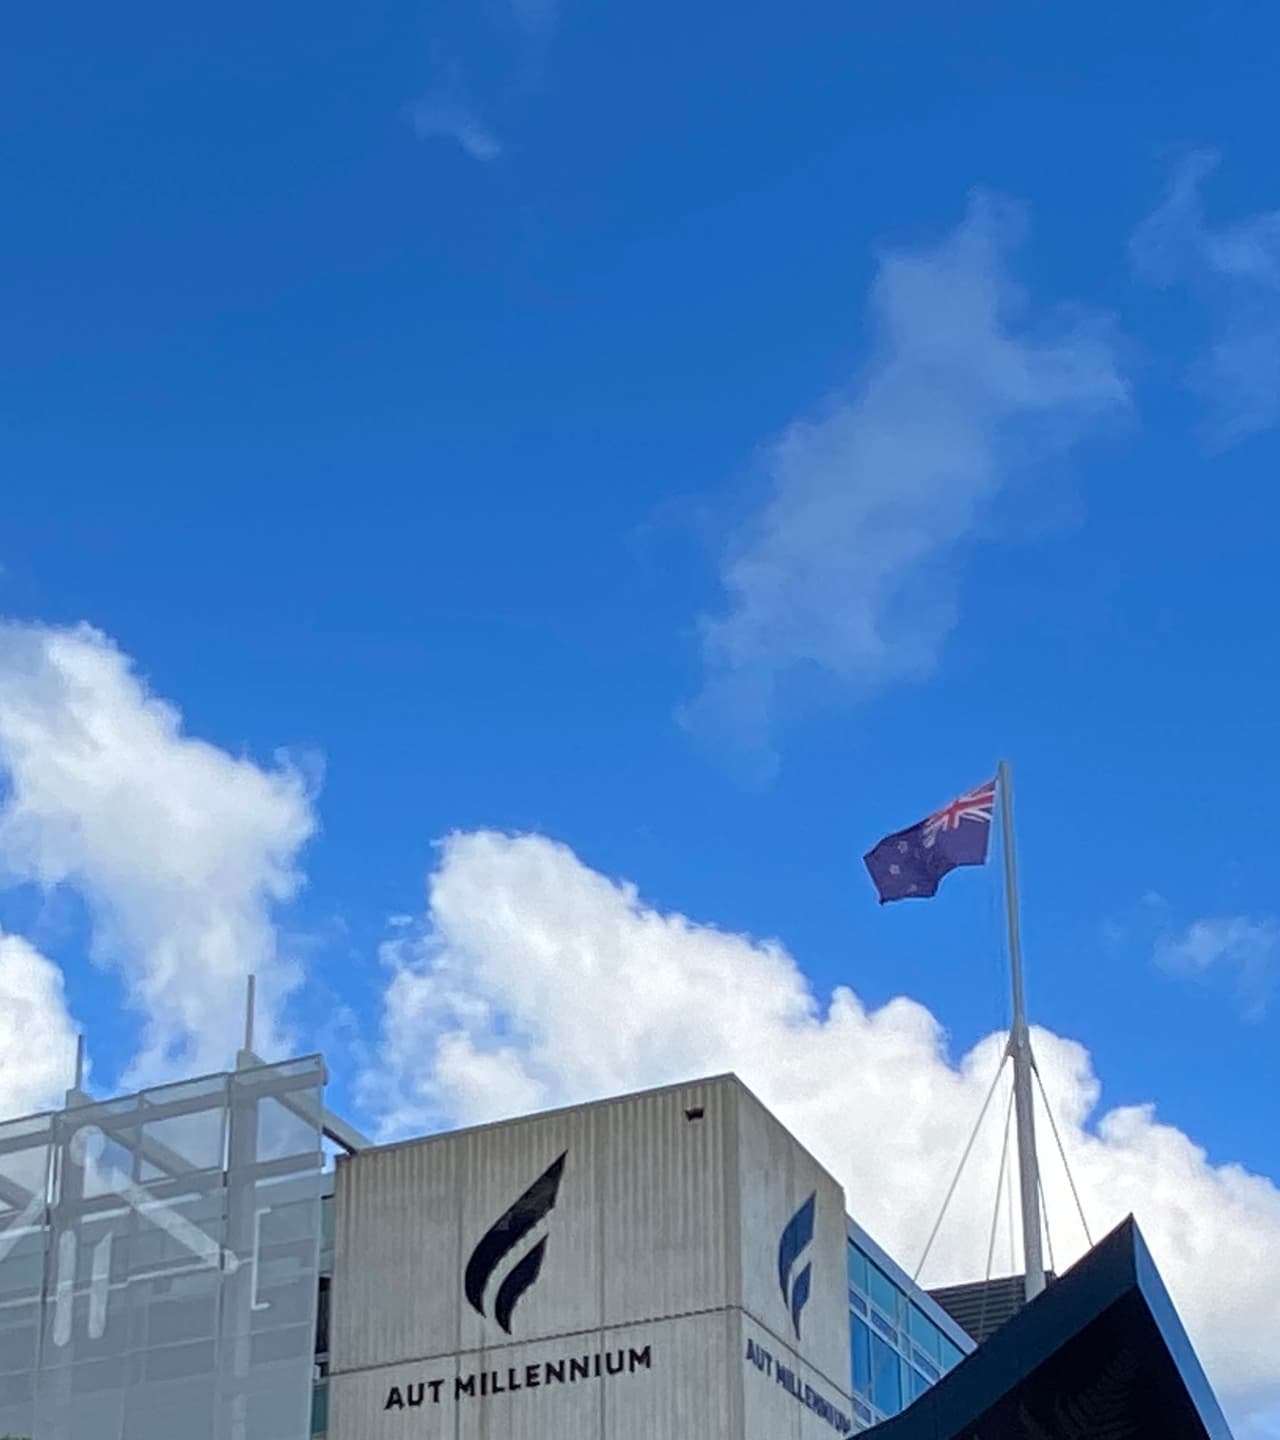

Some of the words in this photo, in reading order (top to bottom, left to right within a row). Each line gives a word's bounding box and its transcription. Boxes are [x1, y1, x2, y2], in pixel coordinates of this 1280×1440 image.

[384, 1379, 445, 1410] AUT
[454, 1345, 652, 1401] MILLENNIUM
[746, 1338, 772, 1376] AUT
